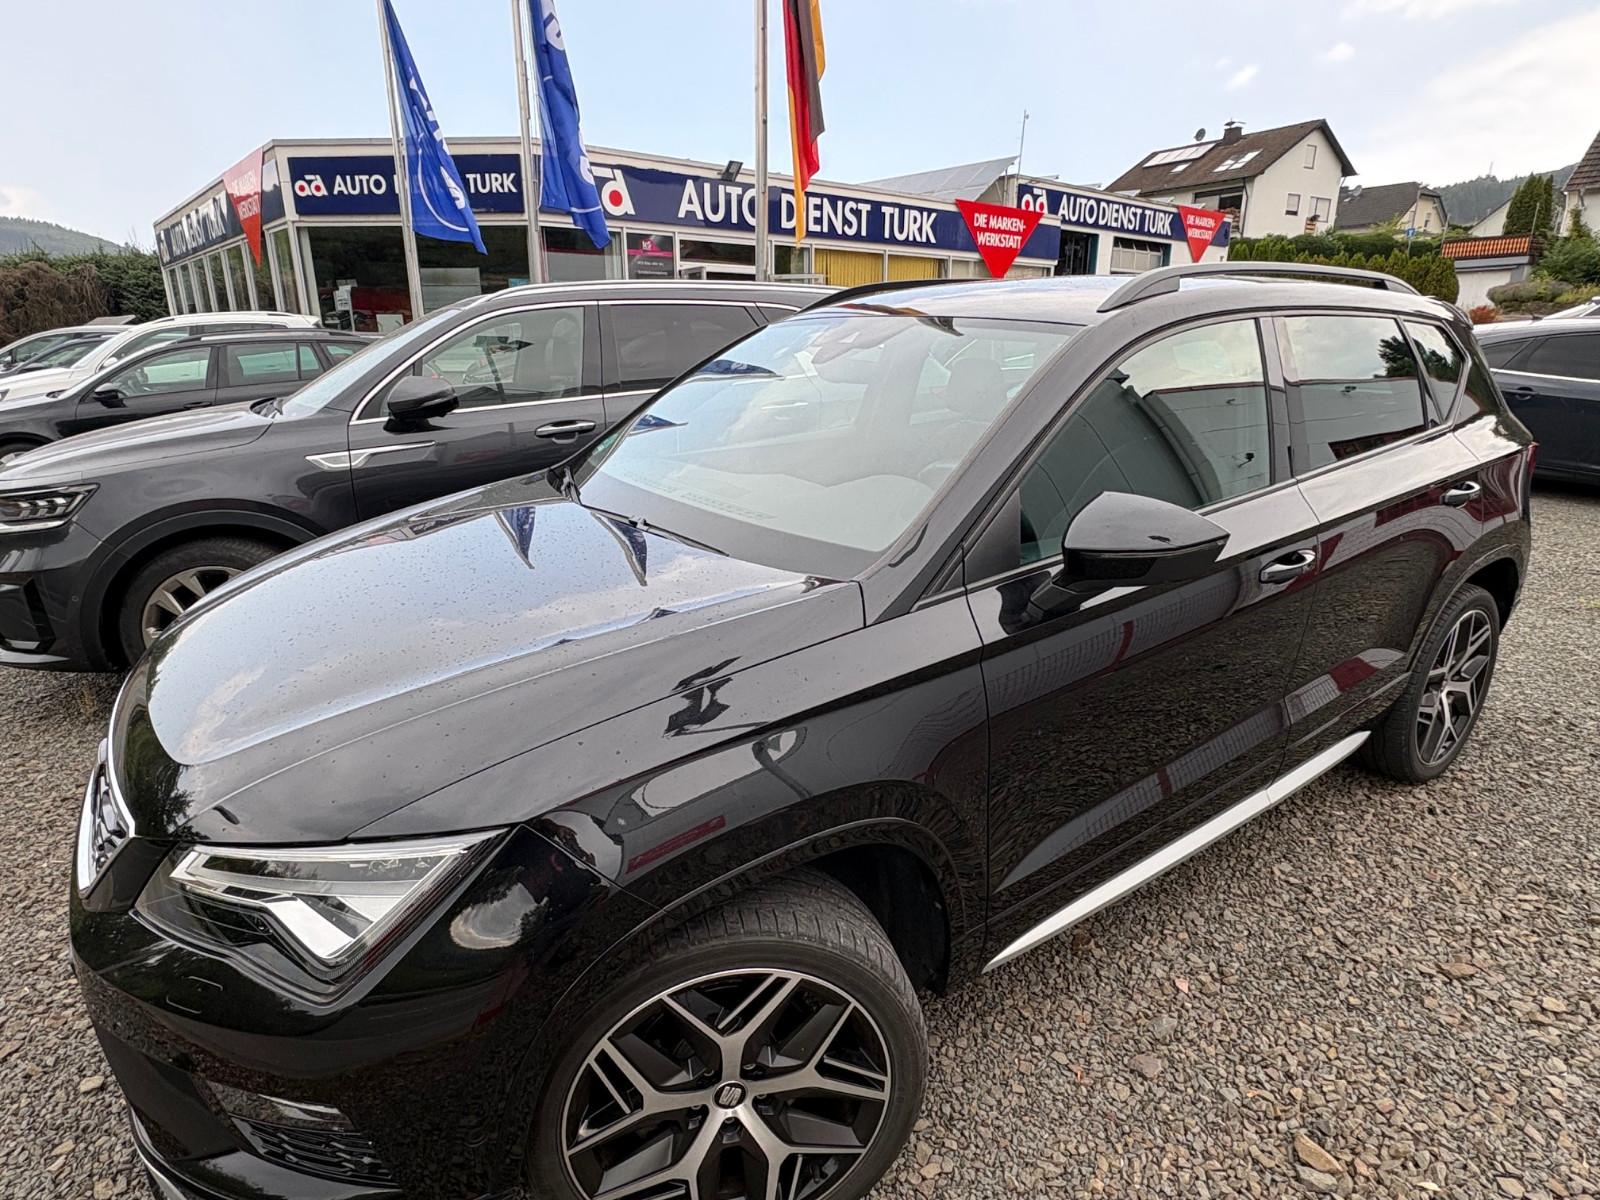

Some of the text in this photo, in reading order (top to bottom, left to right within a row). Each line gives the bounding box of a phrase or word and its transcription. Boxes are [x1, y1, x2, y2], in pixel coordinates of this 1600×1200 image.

[333, 174, 387, 195] AUTO
[465, 172, 518, 194] TURK
[780, 192, 872, 238] DENST
[880, 205, 938, 245] TURK
[973, 212, 1026, 233] DIE MARKEN-
[1057, 193, 1098, 225] AUTO
[1098, 201, 1142, 232] DIENST
[1143, 209, 1174, 236] TURK
[976, 231, 1022, 249] WERKSTATT
